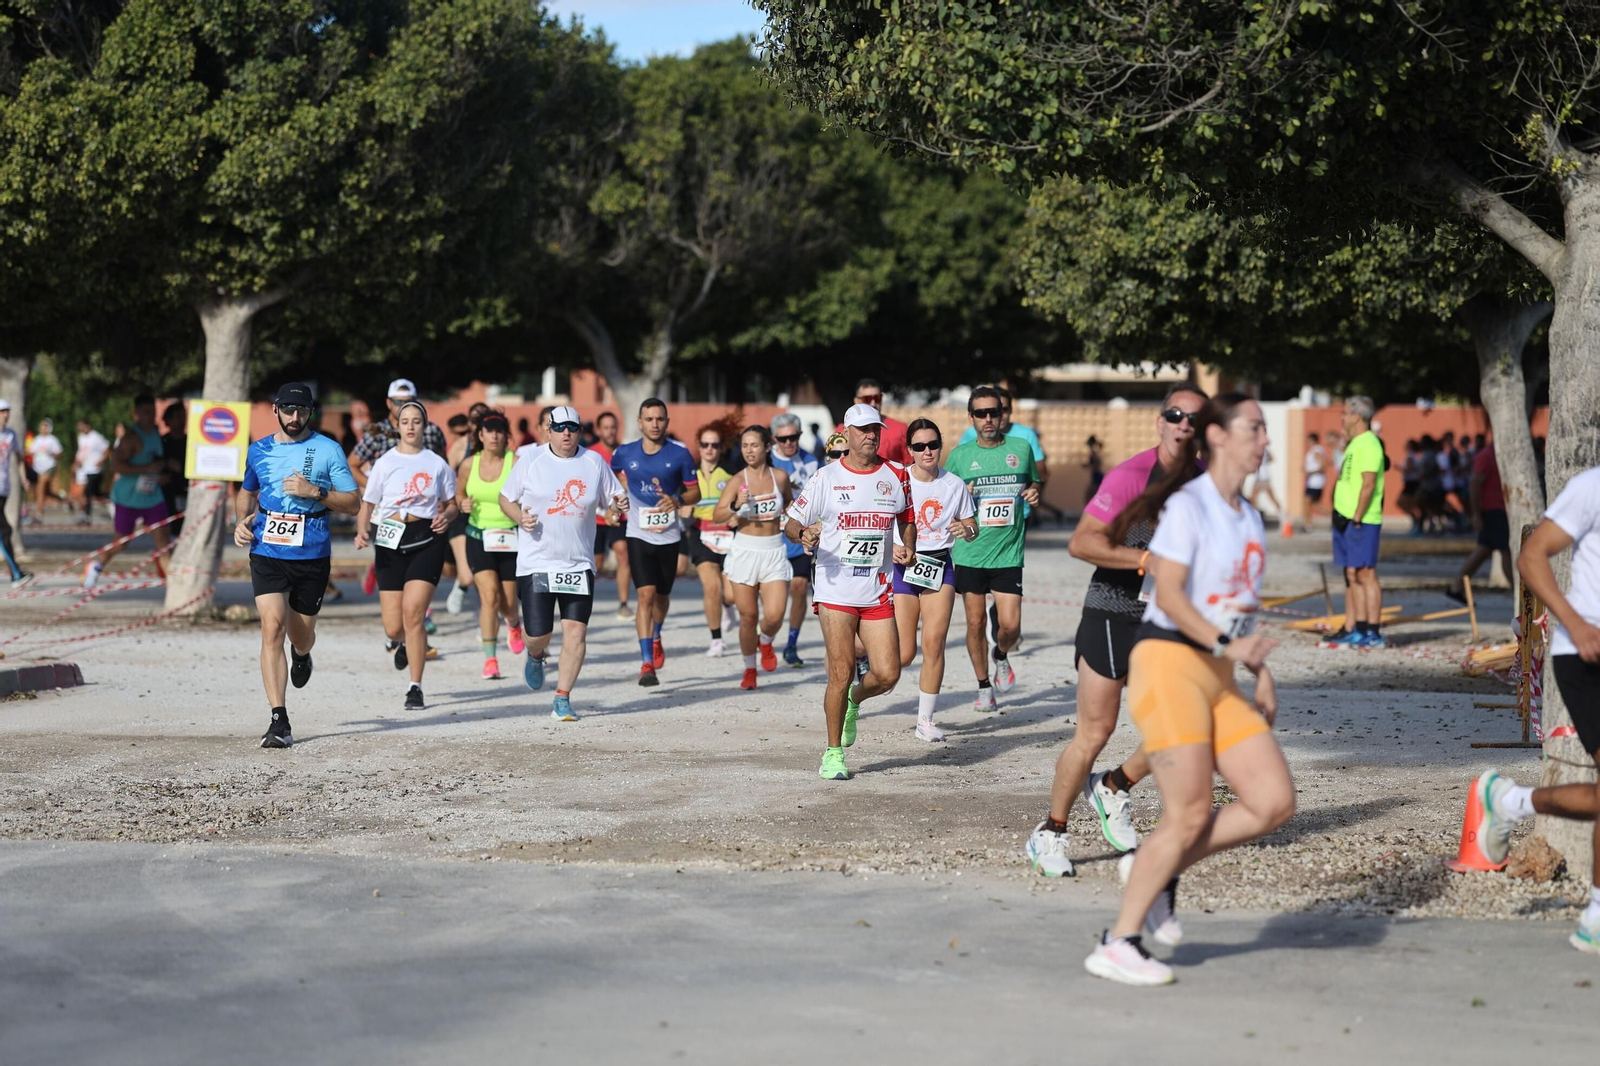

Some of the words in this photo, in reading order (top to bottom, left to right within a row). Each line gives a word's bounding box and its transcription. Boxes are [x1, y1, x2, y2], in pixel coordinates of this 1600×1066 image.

[976, 475, 1017, 485] ATLETISMO
[753, 500, 776, 514] 132
[985, 505, 1010, 518] 105
[646, 513, 669, 525] 133
[844, 513, 894, 530] NutriSpor
[267, 520, 298, 536] 264
[377, 525, 398, 539] 556
[497, 535, 505, 543] 4
[847, 541, 879, 556] 745
[913, 562, 939, 580] 681
[554, 573, 582, 586] 582
